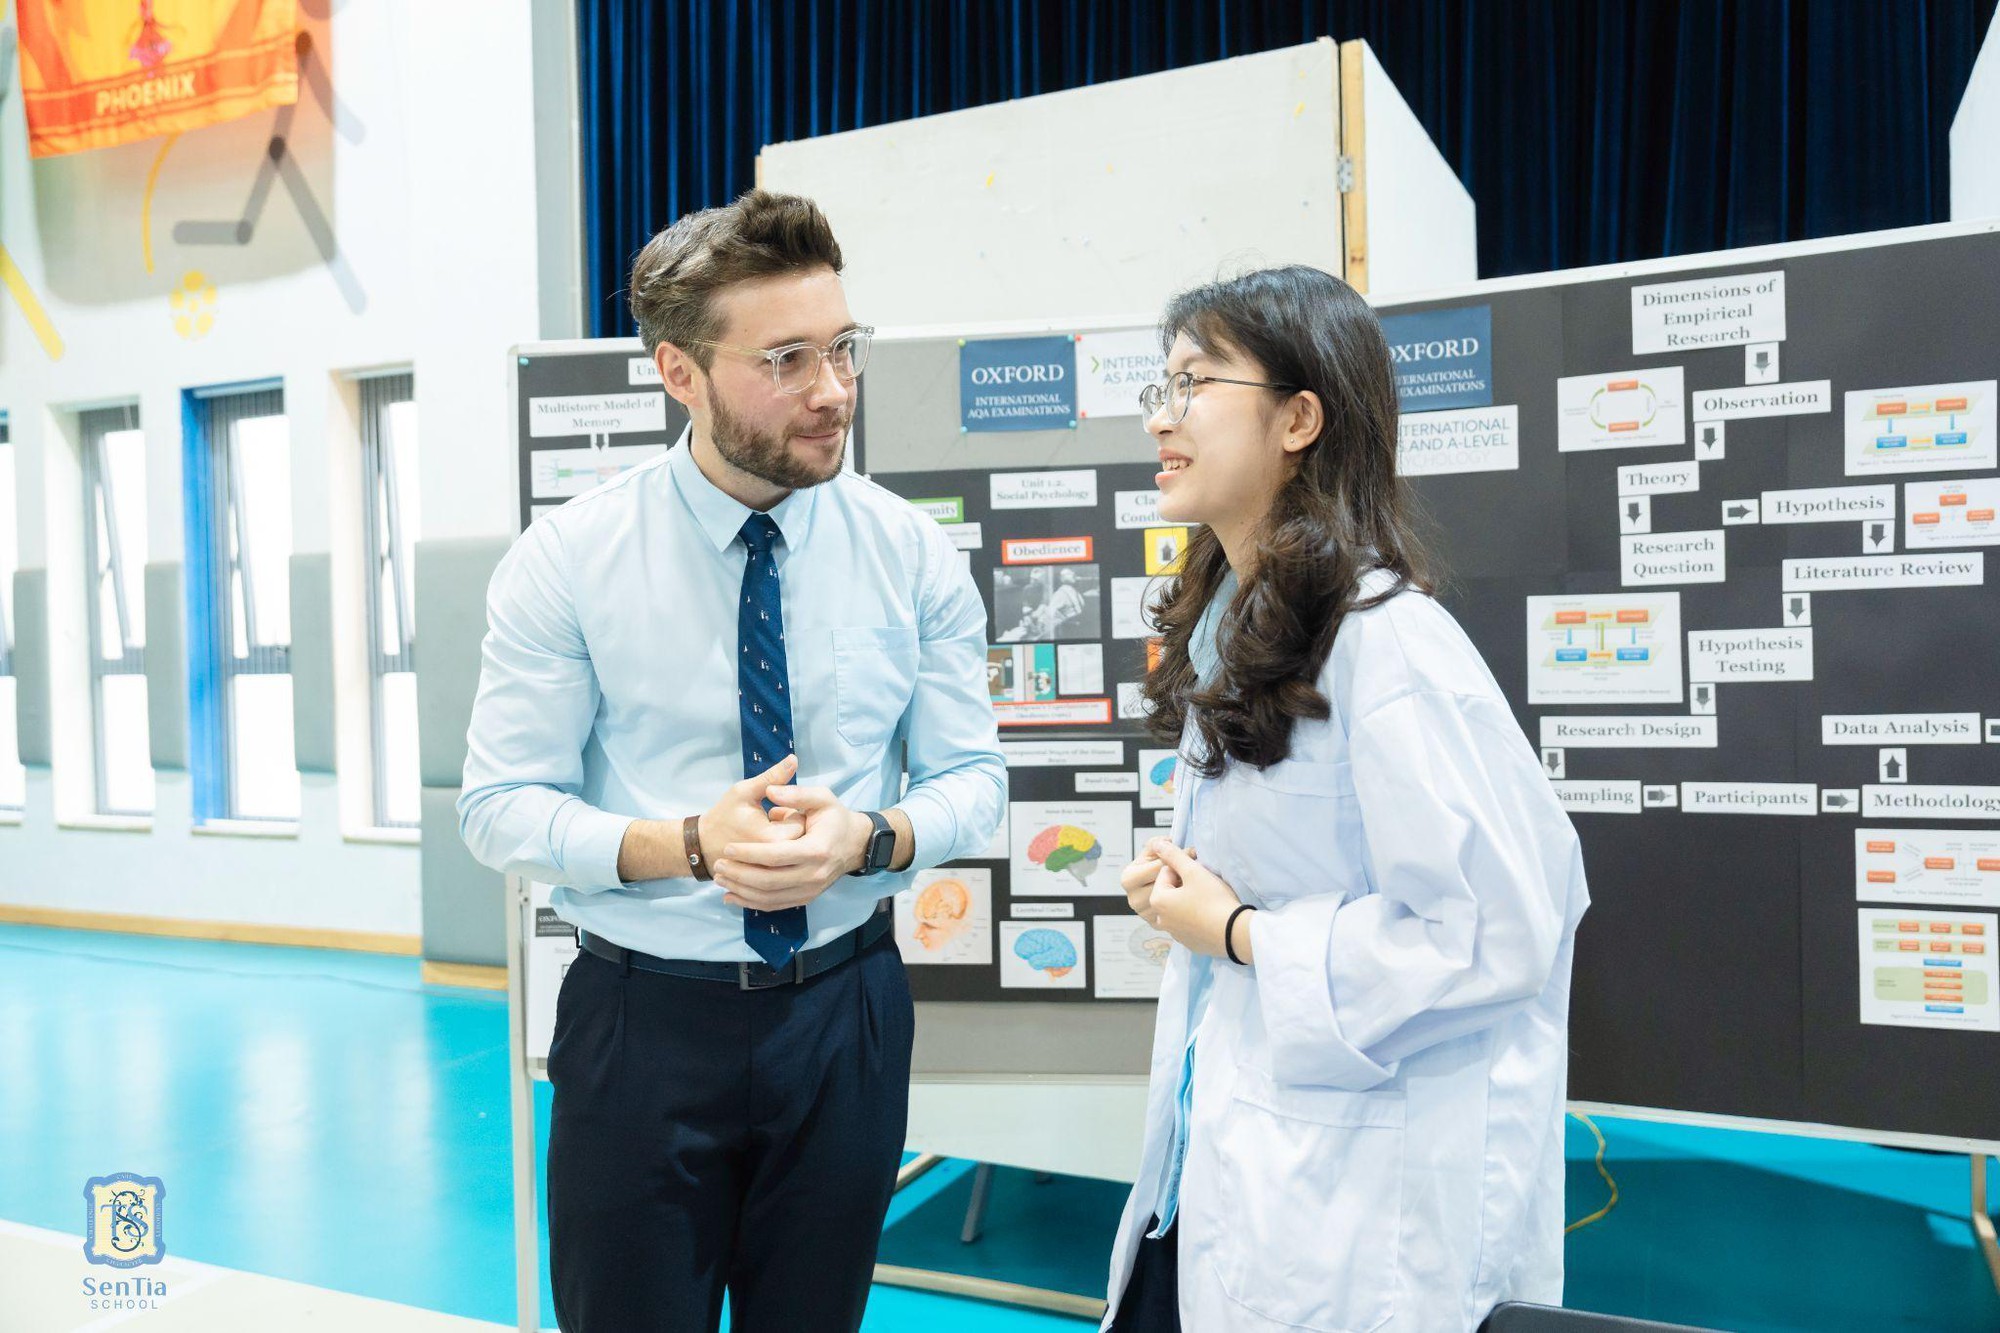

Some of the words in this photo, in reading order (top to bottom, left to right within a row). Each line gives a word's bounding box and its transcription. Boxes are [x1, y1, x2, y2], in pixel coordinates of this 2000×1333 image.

[95, 70, 197, 117] PHOENIX
[1642, 285, 1751, 306] Dimensions
[1756, 279, 1777, 294] of
[1663, 303, 1753, 328] Empirical
[1667, 326, 1751, 347] Research
[636, 364, 660, 376] Un
[1102, 355, 1166, 370] INTERNA
[971, 364, 1065, 385] OXFORD
[1103, 372, 1121, 384] AS
[1125, 370, 1158, 383] AND
[1394, 369, 1476, 385] NTERNATIONAL
[1400, 380, 1486, 398] EXAMINATIONS
[538, 401, 600, 414] Multistore
[604, 398, 641, 411] Model
[643, 397, 657, 408] of
[975, 393, 1062, 407] INTERNATIONAL
[1703, 391, 1819, 412] Observation
[967, 407, 990, 419] AQA
[991, 404, 1071, 418] EXAMINATIONS
[572, 418, 622, 429] Memory
[1399, 417, 1510, 437] TERNATIONAL
[1410, 437, 1443, 452] AND
[1447, 433, 1510, 449] A-LEVEL
[1021, 478, 1044, 488] Unit
[1625, 472, 1691, 487] Theory
[996, 489, 1030, 500] Social
[1031, 485, 1090, 500] Psychology
[1135, 494, 1158, 505] Cla
[1776, 495, 1885, 516] Hypothesis
[1012, 543, 1082, 556] Obedience
[1632, 538, 1715, 554] Research
[1633, 560, 1715, 578] Question
[1794, 564, 1894, 580] Literature
[1900, 560, 1974, 576] Review
[1699, 637, 1803, 655] Hypothesis
[1715, 659, 1786, 675] Testing
[1556, 722, 1635, 737] Research
[1641, 722, 1702, 738] Design
[1833, 721, 1879, 736] Data
[1884, 719, 1970, 737] Analysis
[1554, 788, 1634, 804] Sampling
[1694, 789, 1809, 807] Participants
